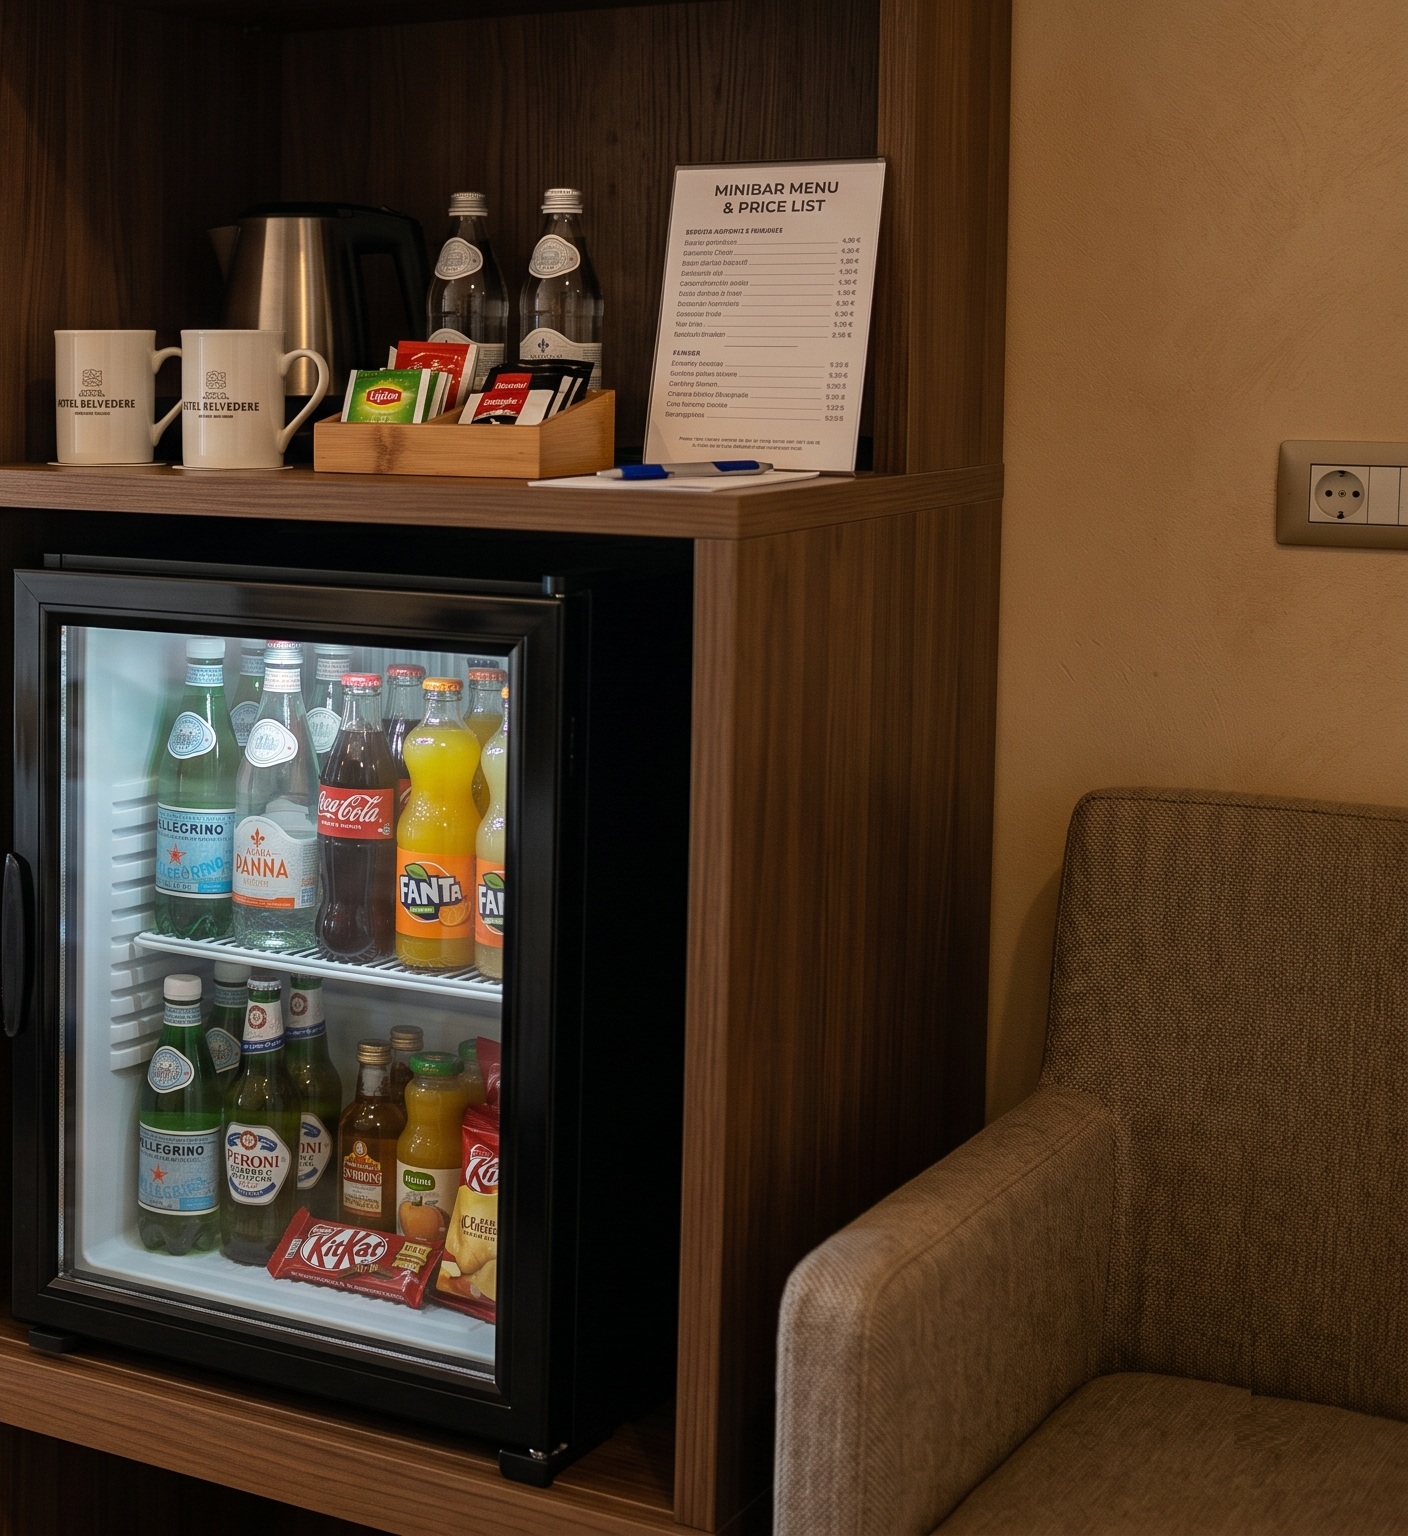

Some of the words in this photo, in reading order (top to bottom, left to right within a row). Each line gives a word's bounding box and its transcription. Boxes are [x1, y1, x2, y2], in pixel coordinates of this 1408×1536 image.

[714, 183, 785, 197] MINIBAR
[789, 181, 840, 195] MENU
[722, 202, 734, 214] &
[738, 201, 787, 214] PRICE
[791, 199, 826, 212] LIST
[80, 399, 135, 409] BELVEDERE
[158, 818, 224, 836] ELLEGRINO
[235, 853, 289, 879] PANNA
[400, 875, 463, 905] FANTA
[227, 1148, 280, 1169] PERONI
[306, 1229, 386, 1270] KitKat
